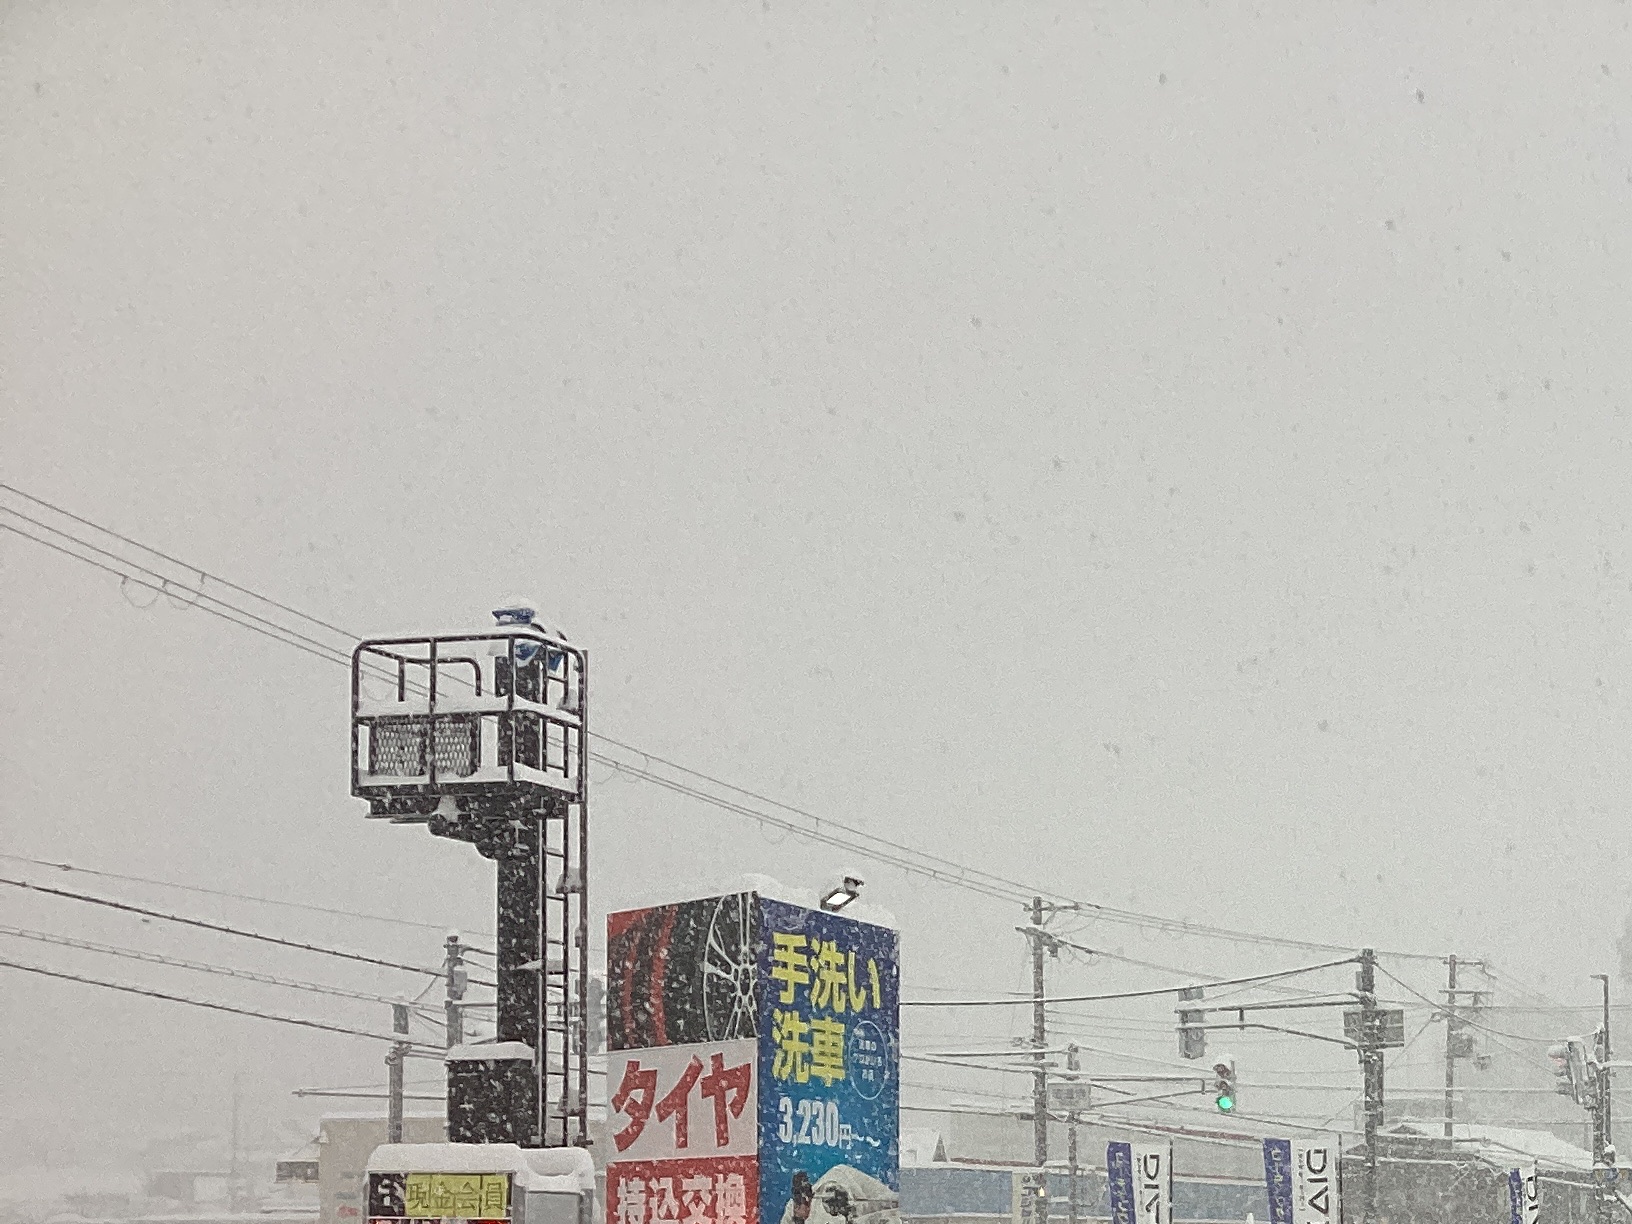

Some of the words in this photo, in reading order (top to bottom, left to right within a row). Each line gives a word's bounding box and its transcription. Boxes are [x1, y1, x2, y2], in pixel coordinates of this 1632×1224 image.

[772, 932, 881, 1012] 手洗い
[772, 1008, 846, 1087] 洗車
[611, 1054, 751, 1152] タイヤ
[407, 1181, 504, 1210] 現金会員
